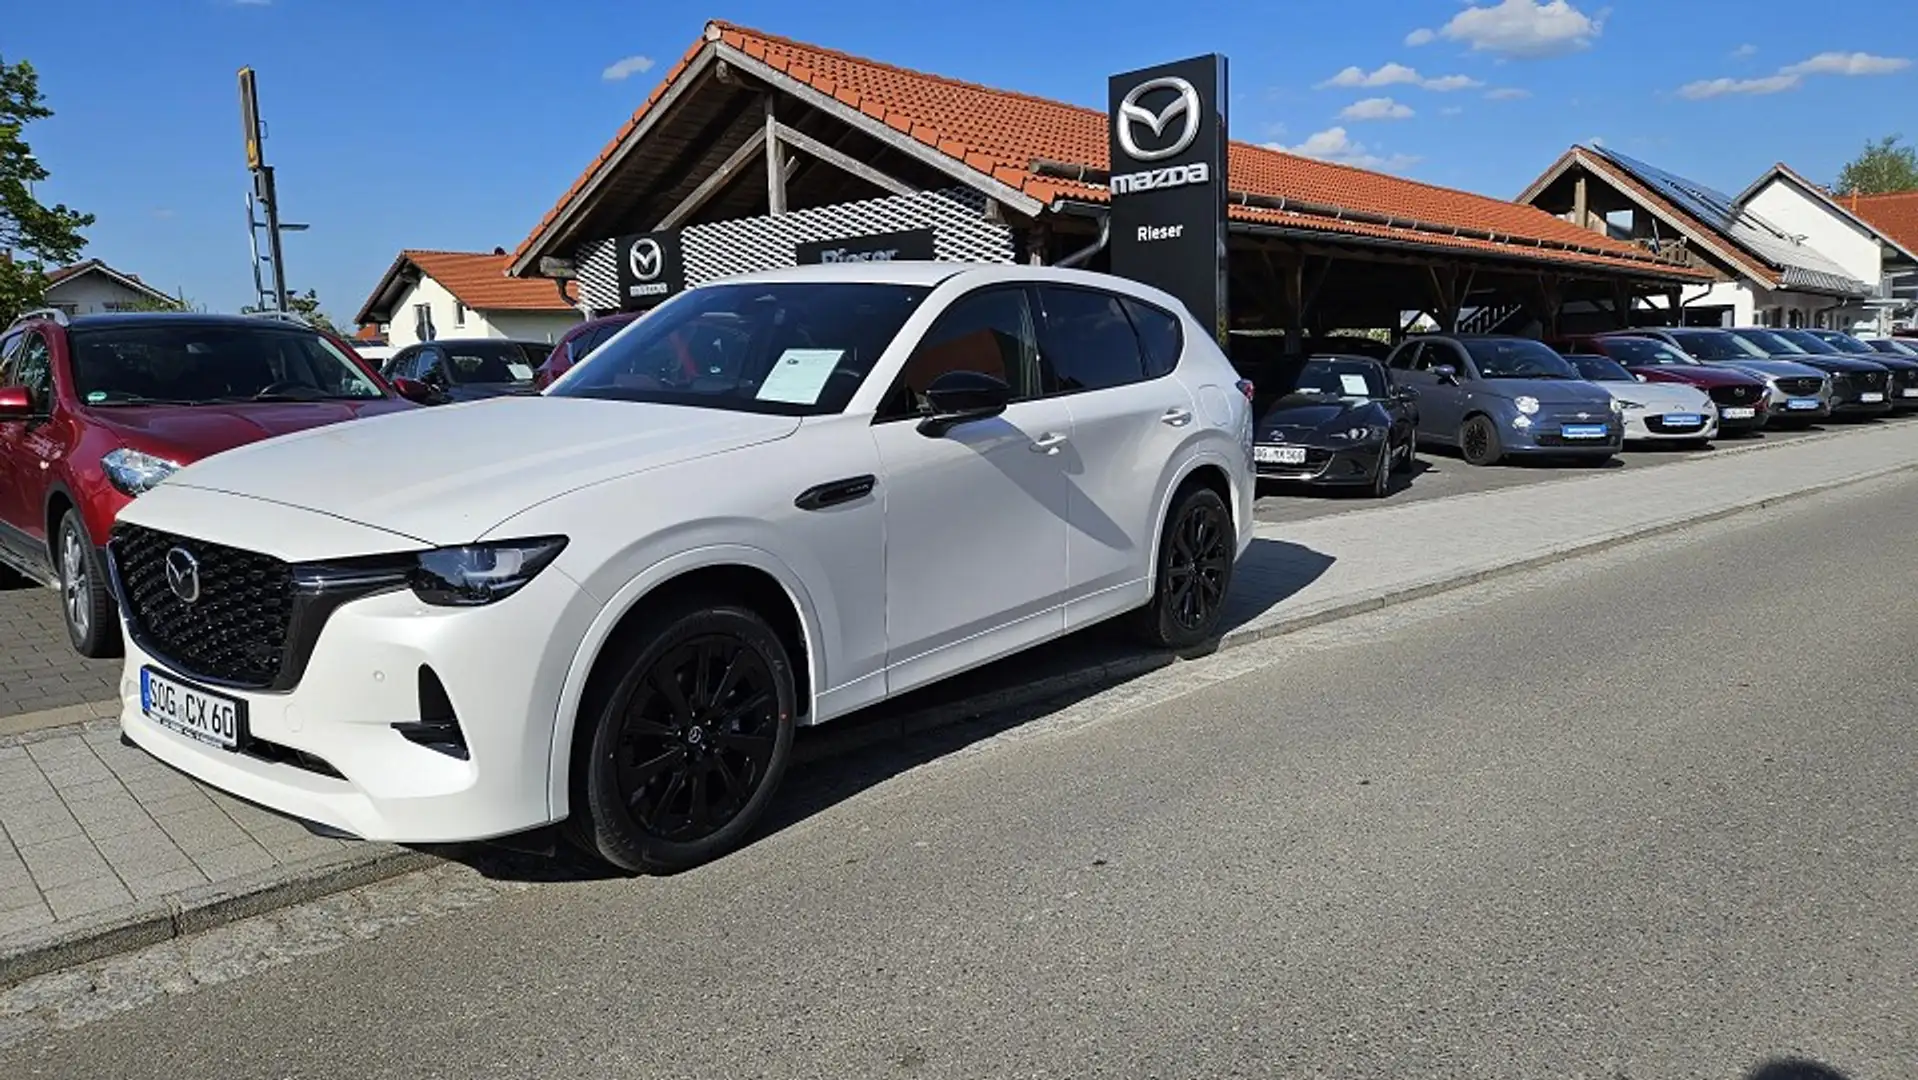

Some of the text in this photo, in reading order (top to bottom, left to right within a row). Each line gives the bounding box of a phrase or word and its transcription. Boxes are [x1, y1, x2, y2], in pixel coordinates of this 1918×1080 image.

[1110, 162, 1209, 195] mazda
[1137, 224, 1184, 242] Rieser
[150, 678, 176, 716] SOG
[185, 693, 208, 730] CX
[211, 703, 234, 739] 60
